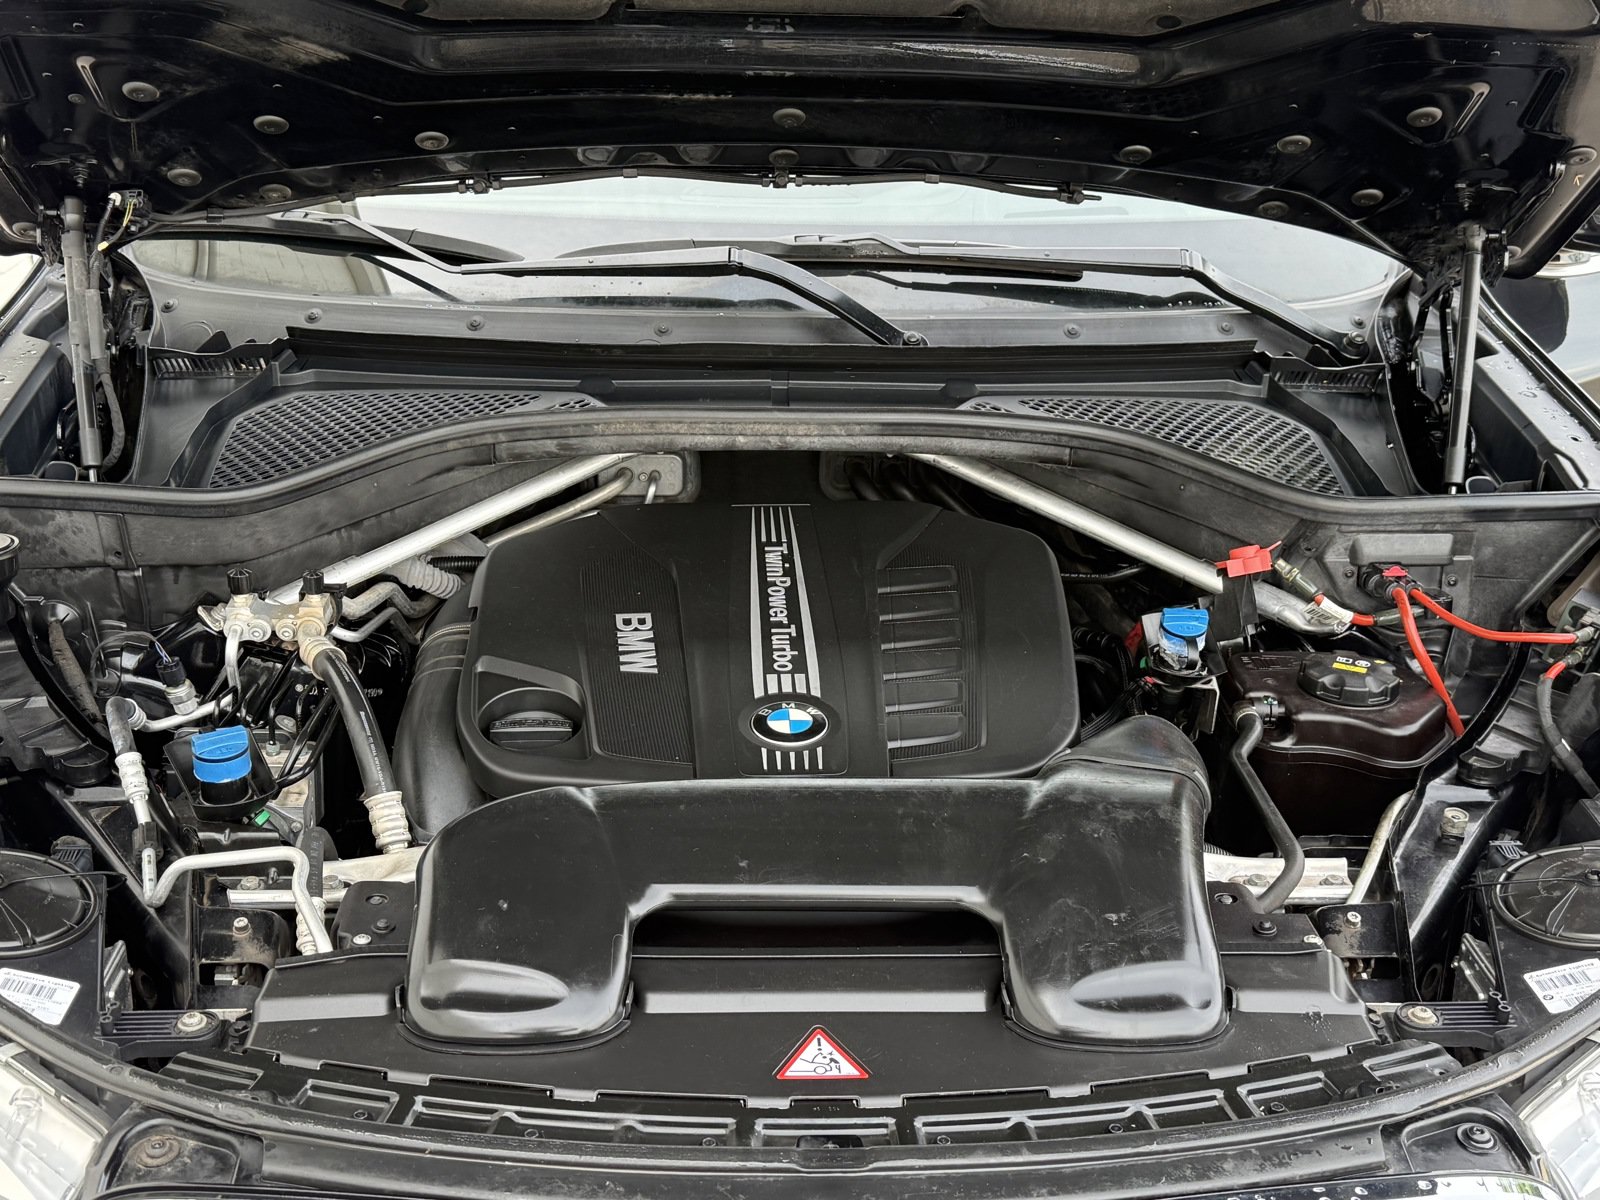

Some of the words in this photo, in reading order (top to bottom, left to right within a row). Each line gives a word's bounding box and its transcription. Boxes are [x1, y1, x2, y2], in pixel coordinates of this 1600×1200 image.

[764, 542, 792, 624] TwinPower
[615, 612, 658, 674] BMW
[770, 625, 799, 672] Turbo
[758, 702, 820, 717] BMW
